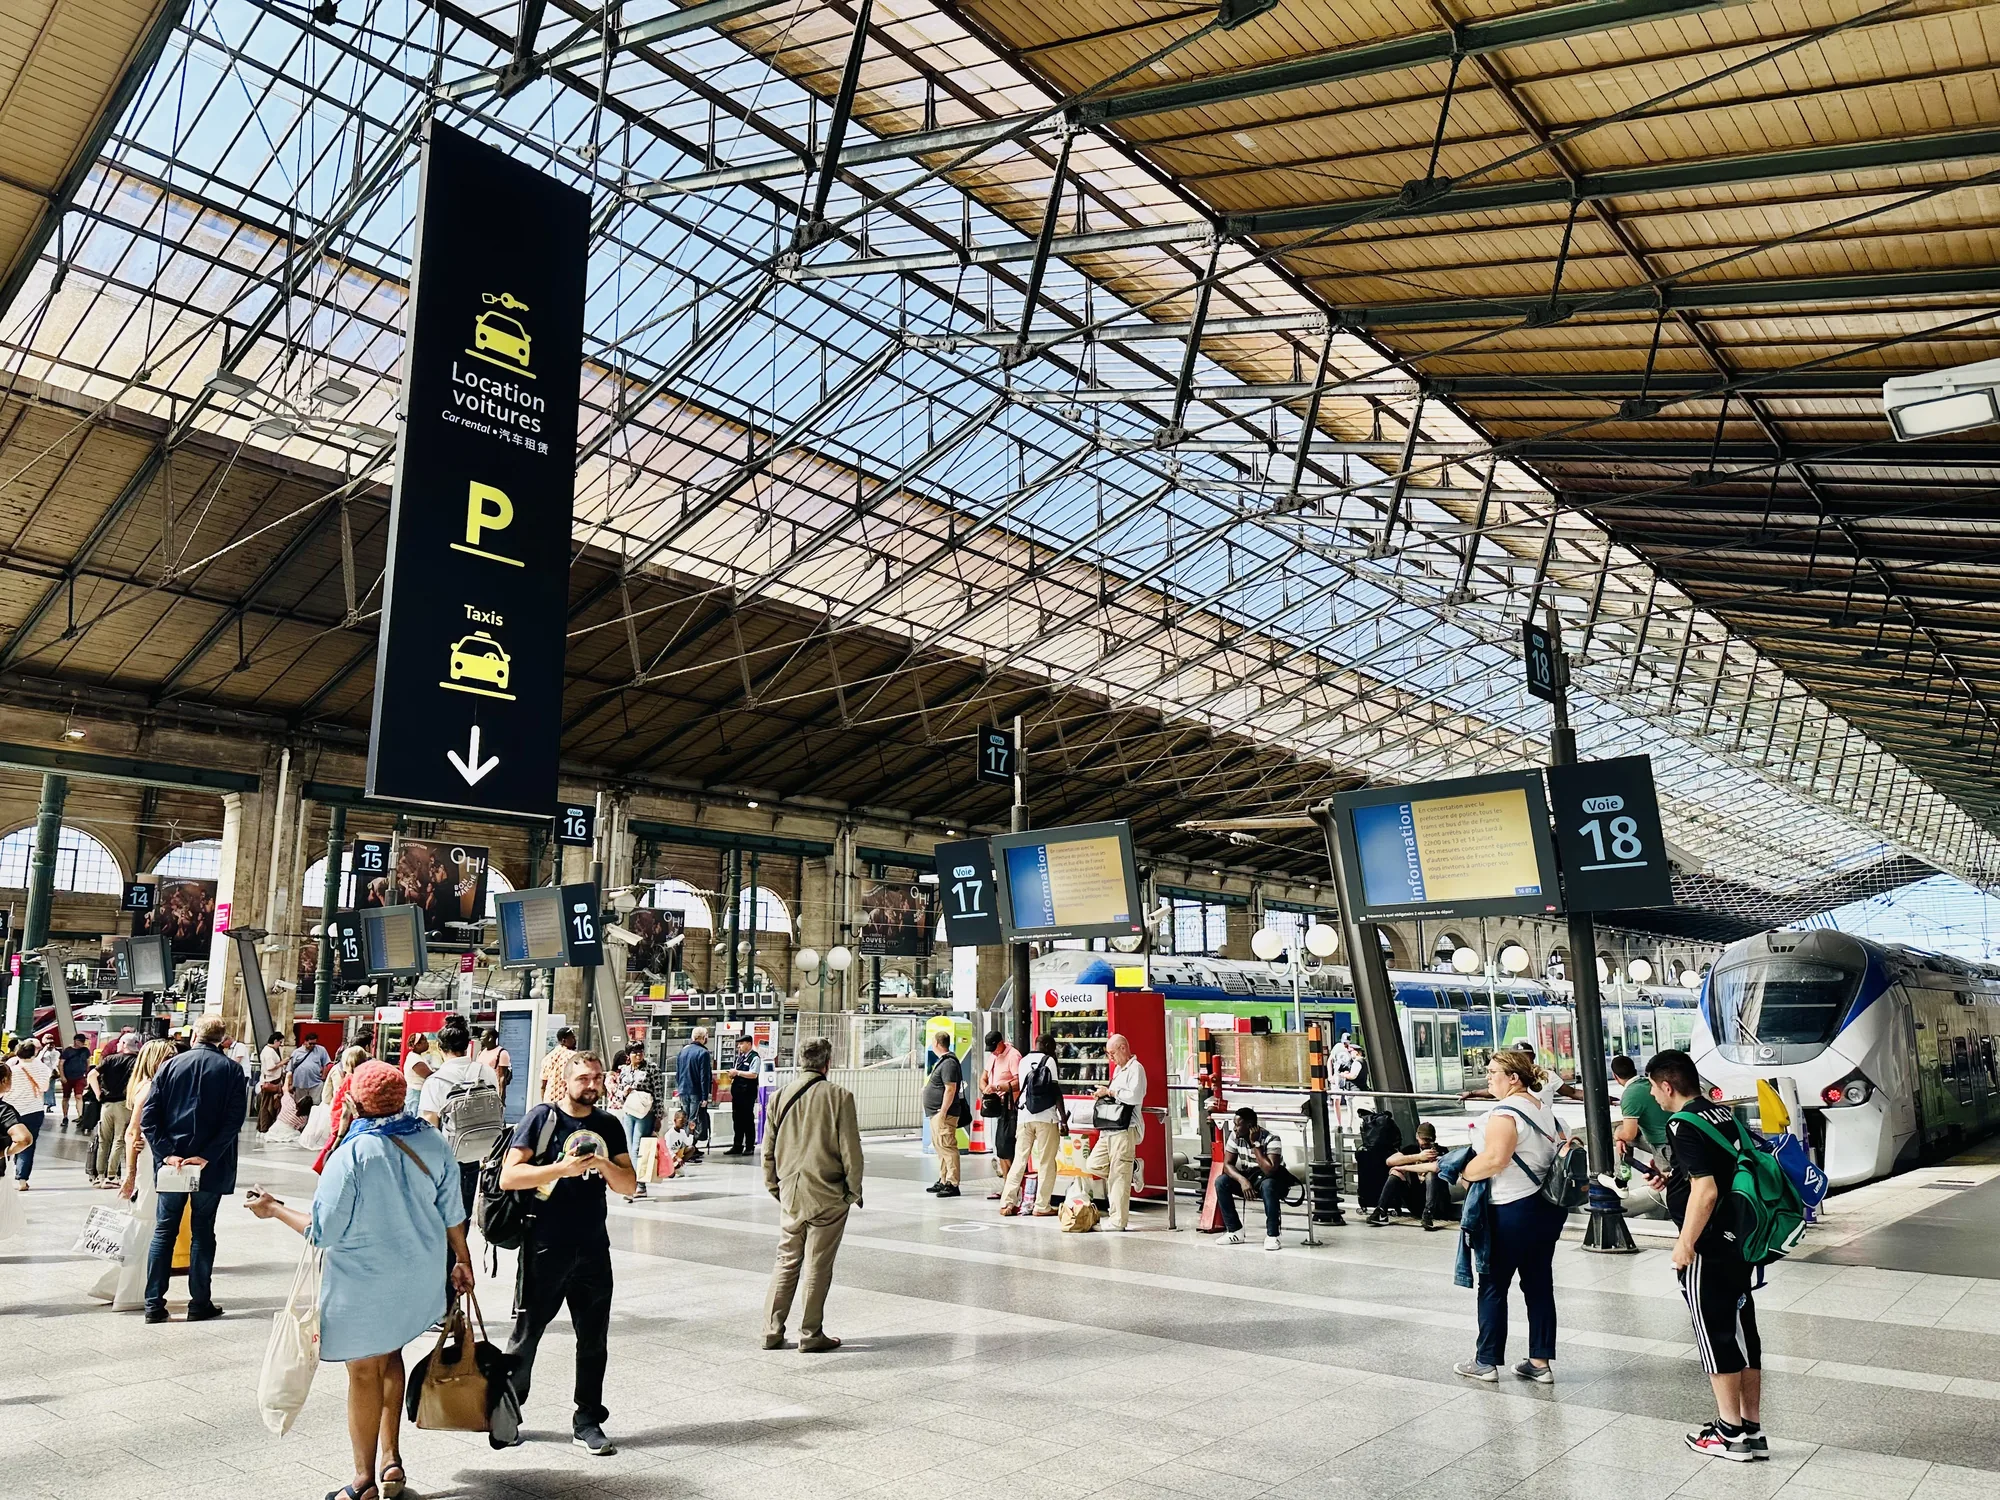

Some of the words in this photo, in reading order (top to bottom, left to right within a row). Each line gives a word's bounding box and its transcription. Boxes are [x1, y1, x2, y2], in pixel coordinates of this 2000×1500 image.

[452, 361, 545, 413] Location
[442, 410, 460, 424] Car
[461, 418, 491, 434] rental
[452, 389, 541, 433] voitures
[499, 428, 548, 455] 汽车租赁
[466, 480, 514, 546] P
[464, 604, 504, 626] Taxis
[1532, 649, 1550, 684] 18
[991, 736, 1004, 744] Voie
[987, 747, 1008, 772] 17
[1427, 803, 1463, 812] concertation
[1587, 798, 1618, 811] Voie
[564, 817, 586, 837] 16
[1578, 816, 1642, 861] 18
[361, 852, 382, 868] 15
[450, 847, 486, 874] OH!
[1398, 804, 1424, 902] information
[955, 868, 972, 877] Voie
[454, 878, 468, 891] BON
[1038, 846, 1054, 925] information
[130, 892, 148, 904] 14
[910, 886, 930, 906] OH!
[952, 880, 982, 912] 17
[573, 915, 594, 940] 16
[664, 911, 684, 928] OH!
[343, 938, 358, 958] 15
[118, 961, 128, 976] 14
[1060, 993, 1092, 1003] selecta
